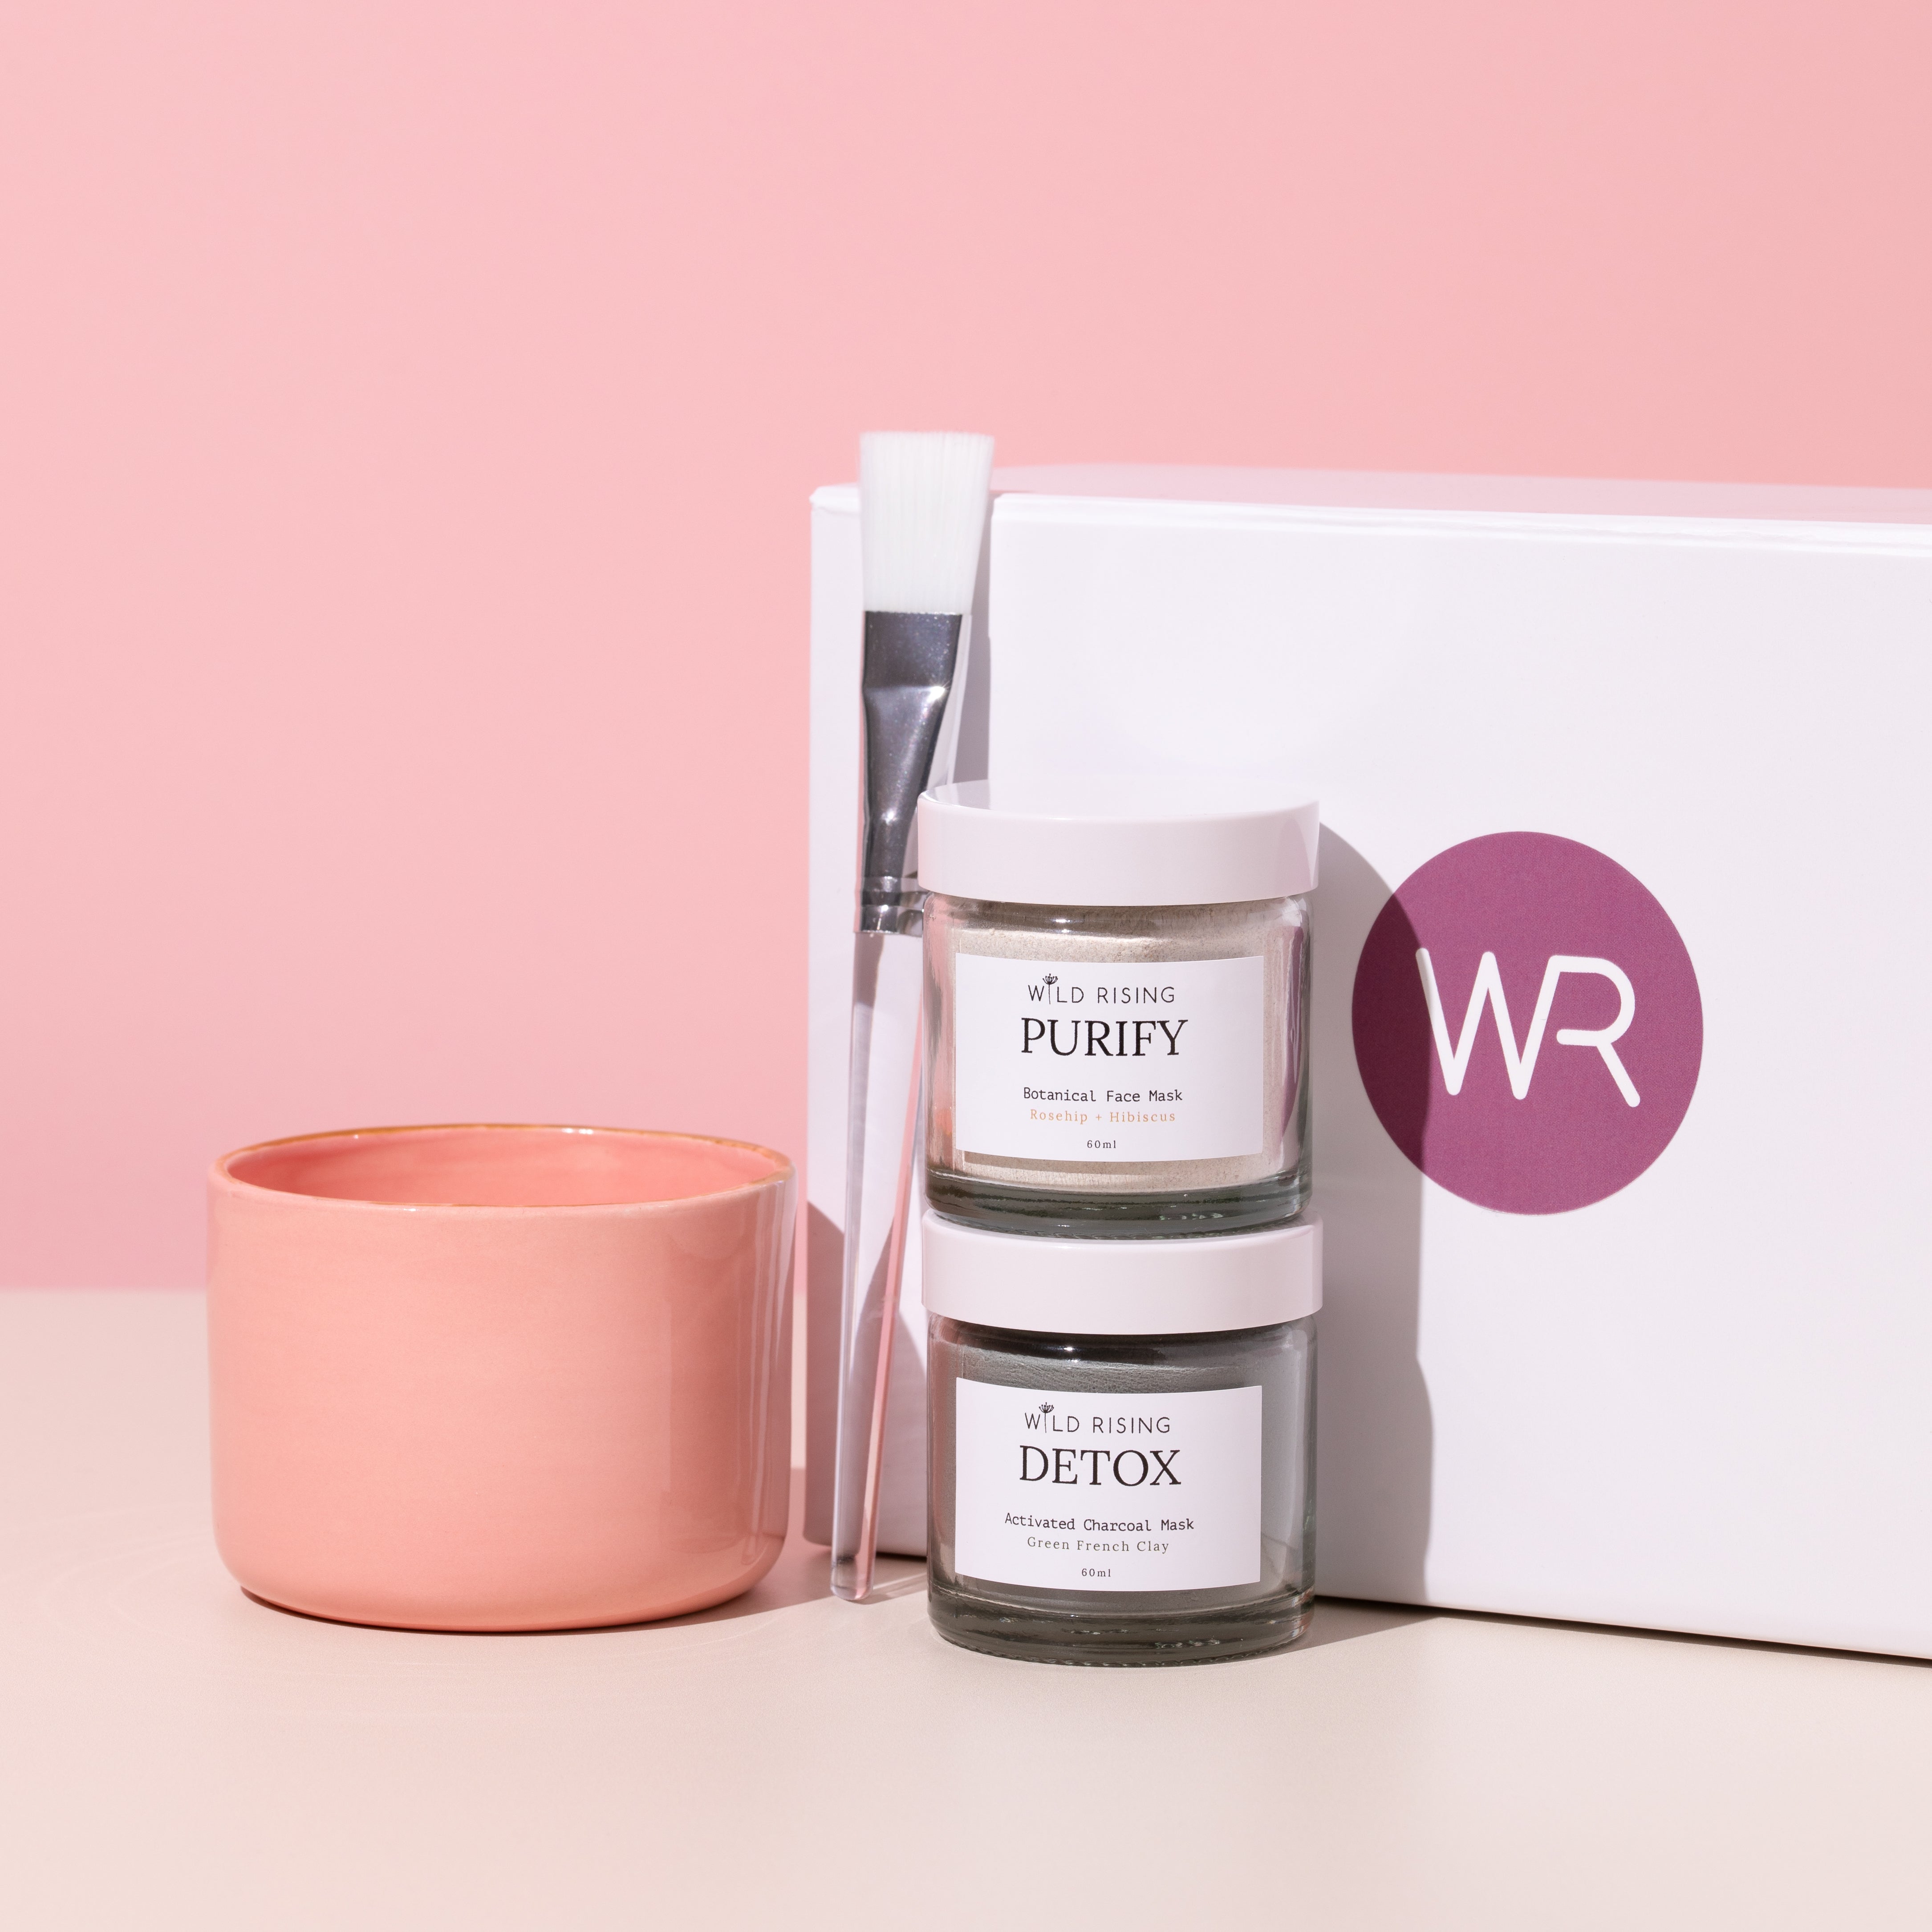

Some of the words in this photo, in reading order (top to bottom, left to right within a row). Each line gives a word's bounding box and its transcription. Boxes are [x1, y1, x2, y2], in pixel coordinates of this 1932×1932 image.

[1027, 973, 1084, 1005] WILD
[1097, 986, 1175, 1004] RISING
[1021, 1017, 1189, 1057] PURIFY
[1415, 947, 1641, 1108] WR
[1023, 1087, 1096, 1102] Botanical
[1107, 1090, 1141, 1102] Face
[1149, 1089, 1183, 1102] Mask
[1030, 1108, 1088, 1125] Rosehip
[1109, 1111, 1176, 1123] Hibiscus
[1087, 1140, 1116, 1149] 60ml
[1024, 1401, 1080, 1433] WILD
[1092, 1417, 1171, 1434] RISING
[1019, 1445, 1182, 1487] DETOX
[1004, 1512, 1076, 1530] Activated
[1083, 1518, 1152, 1532] Charcoal
[1161, 1518, 1194, 1531] Mask
[1027, 1536, 1070, 1550] Green
[1076, 1540, 1130, 1552] French
[1136, 1540, 1169, 1555] Clay
[1081, 1567, 1112, 1577] 60ml
